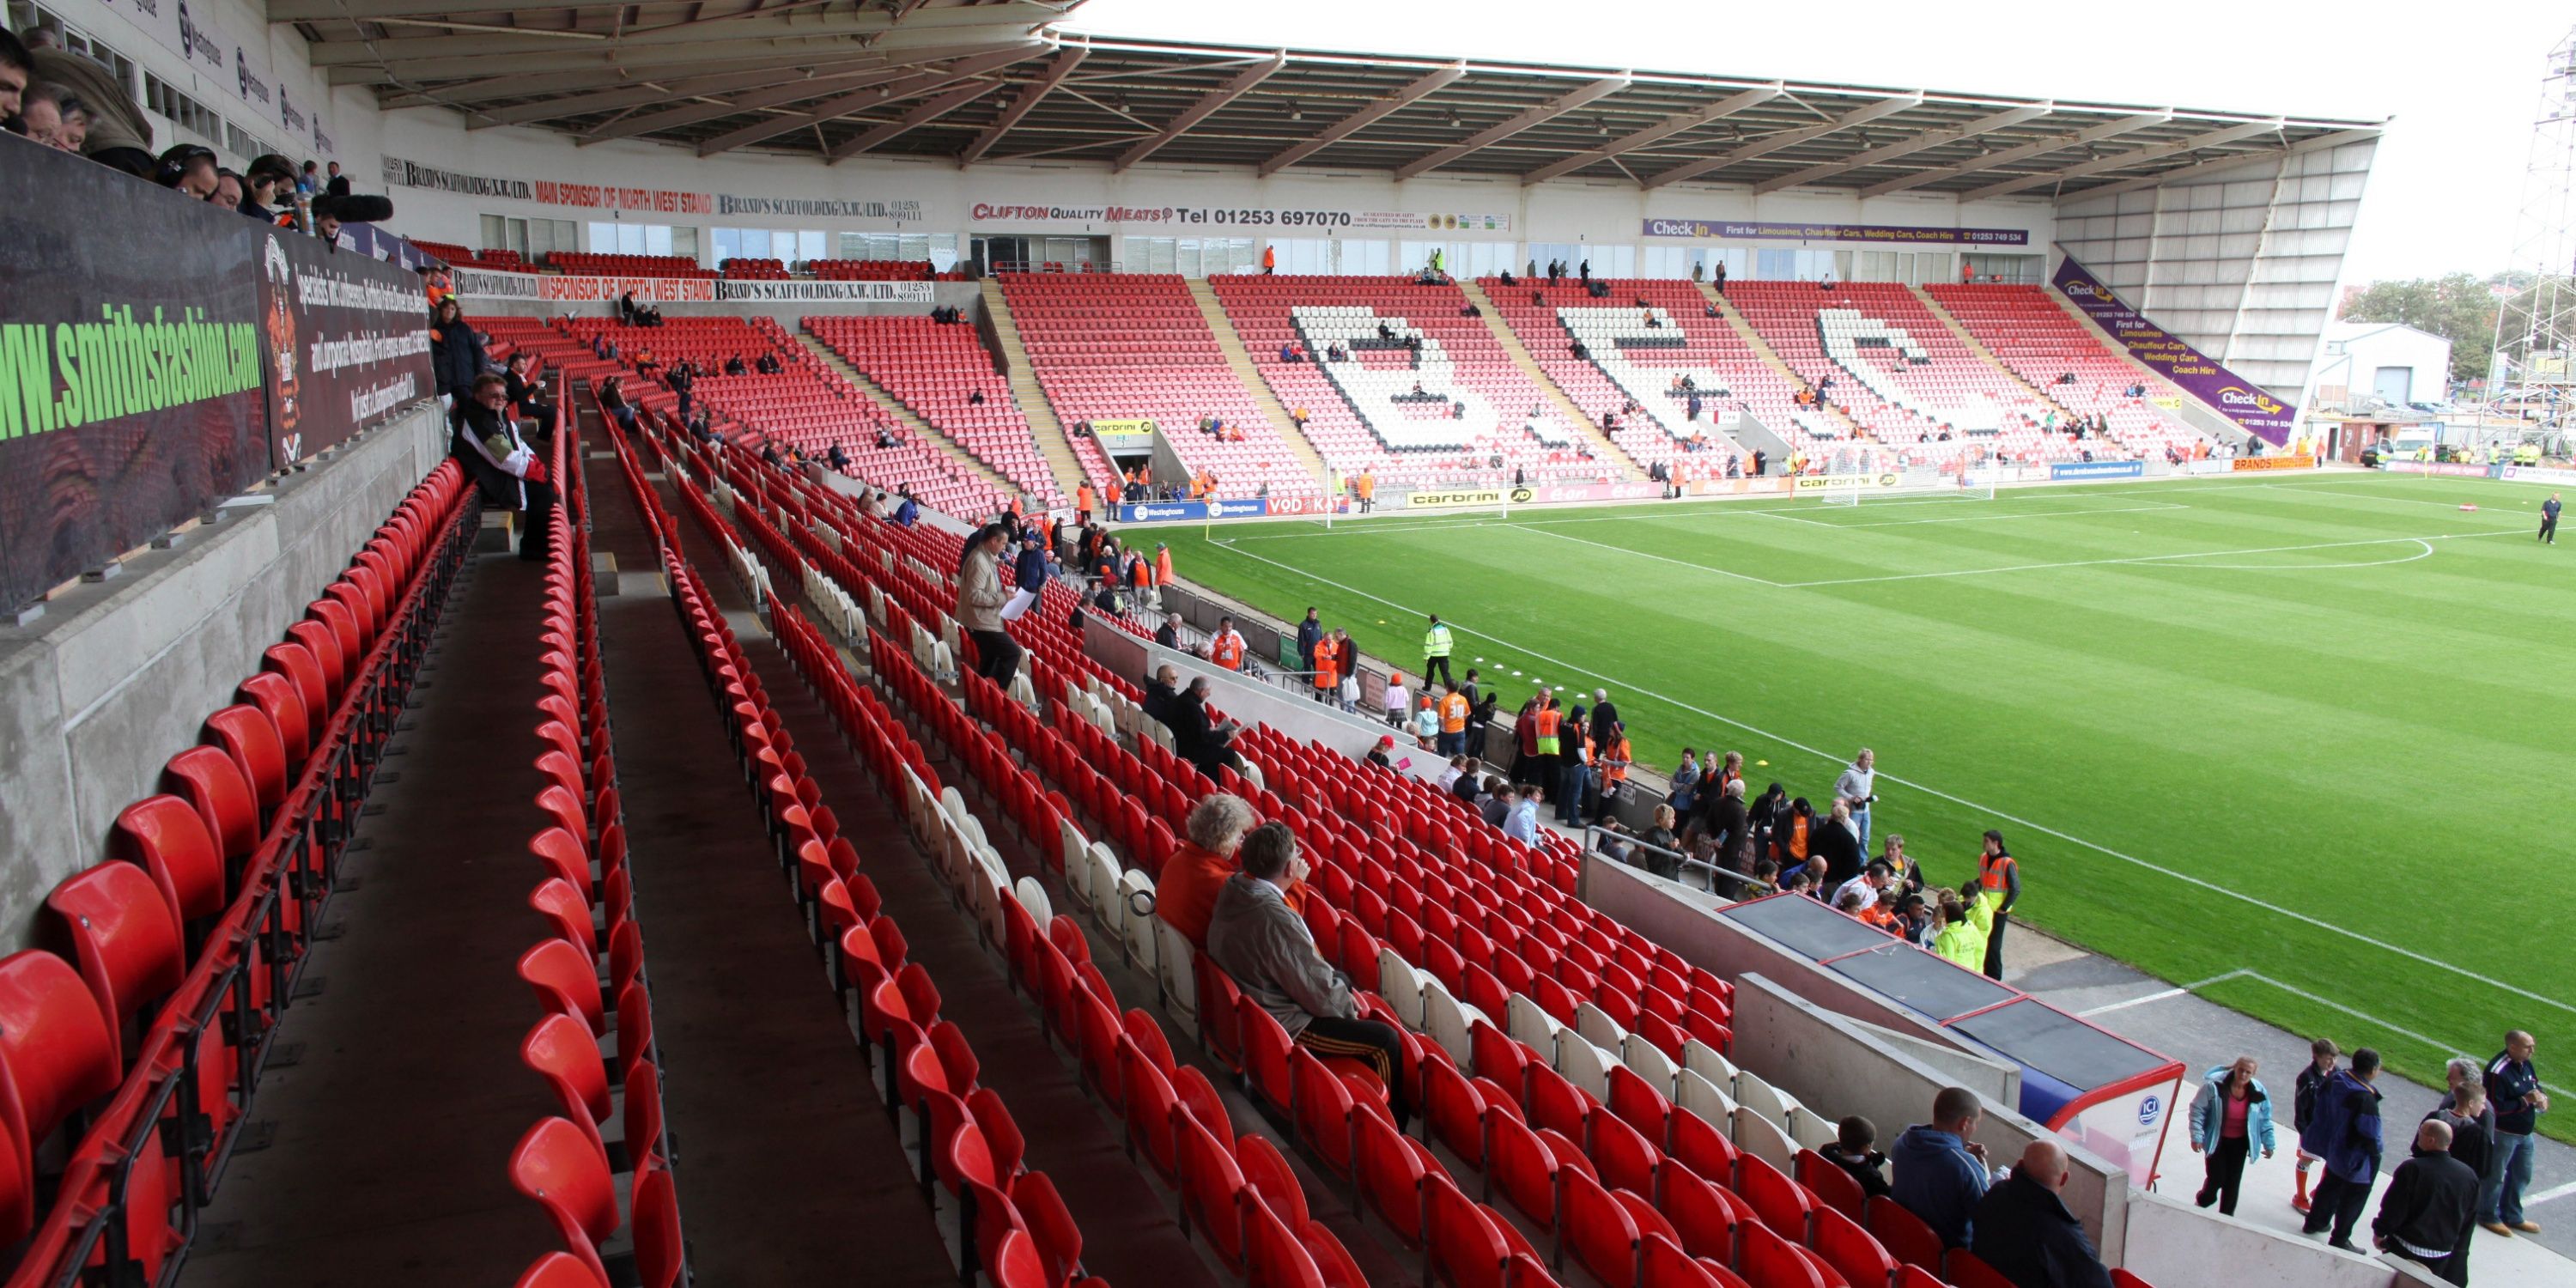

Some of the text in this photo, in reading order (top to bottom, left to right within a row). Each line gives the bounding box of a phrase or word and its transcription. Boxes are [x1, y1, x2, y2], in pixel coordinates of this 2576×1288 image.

[383, 156, 402, 171] 01253
[535, 180, 712, 214] MAIN SPONSOR OF NORTH WEST STAND
[719, 194, 771, 215] BRAND'S
[891, 201, 920, 210] 01253
[889, 210, 922, 221] 899111
[971, 203, 1161, 222] CLIFTON QUALITY MEATS
[1176, 209, 1351, 226] Tel 01253 697070
[1654, 222, 1692, 234] Check
[1726, 226, 1743, 234] First
[1759, 227, 1803, 237] Limousines,
[1805, 228, 1841, 236] Chauffeur
[1844, 228, 1862, 238] Cars,
[1864, 230, 1894, 240] Wedding
[1897, 231, 1915, 240] Cars,
[1917, 231, 1937, 240] Coach
[550, 276, 598, 301] SPONSOR
[602, 276, 615, 301] OF
[618, 277, 651, 301] NORTH
[653, 278, 680, 301] WEST
[683, 279, 713, 301] STAND
[715, 281, 762, 301] BRAND'S
[764, 282, 843, 300] SCAFFOLDING
[900, 282, 930, 292] 01253
[2068, 285, 2094, 295] Check
[897, 292, 933, 301] 899111
[2144, 353, 2198, 362] Wedding Cars
[2172, 365, 2216, 375] Coach Hire
[2222, 392, 2269, 406] Check In
[1094, 422, 1136, 432] carbrini
[2234, 459, 2272, 471] BRANDS
[1800, 477, 1870, 488] carbrini
[1413, 492, 1500, 505] carbrini
[1148, 507, 1185, 517] Westinghouse
[1269, 499, 1303, 513] VOD
[1449, 704, 1465, 719] 30
[2143, 1102, 2156, 1114] ICI
[2129, 1137, 2153, 1151] HOME
